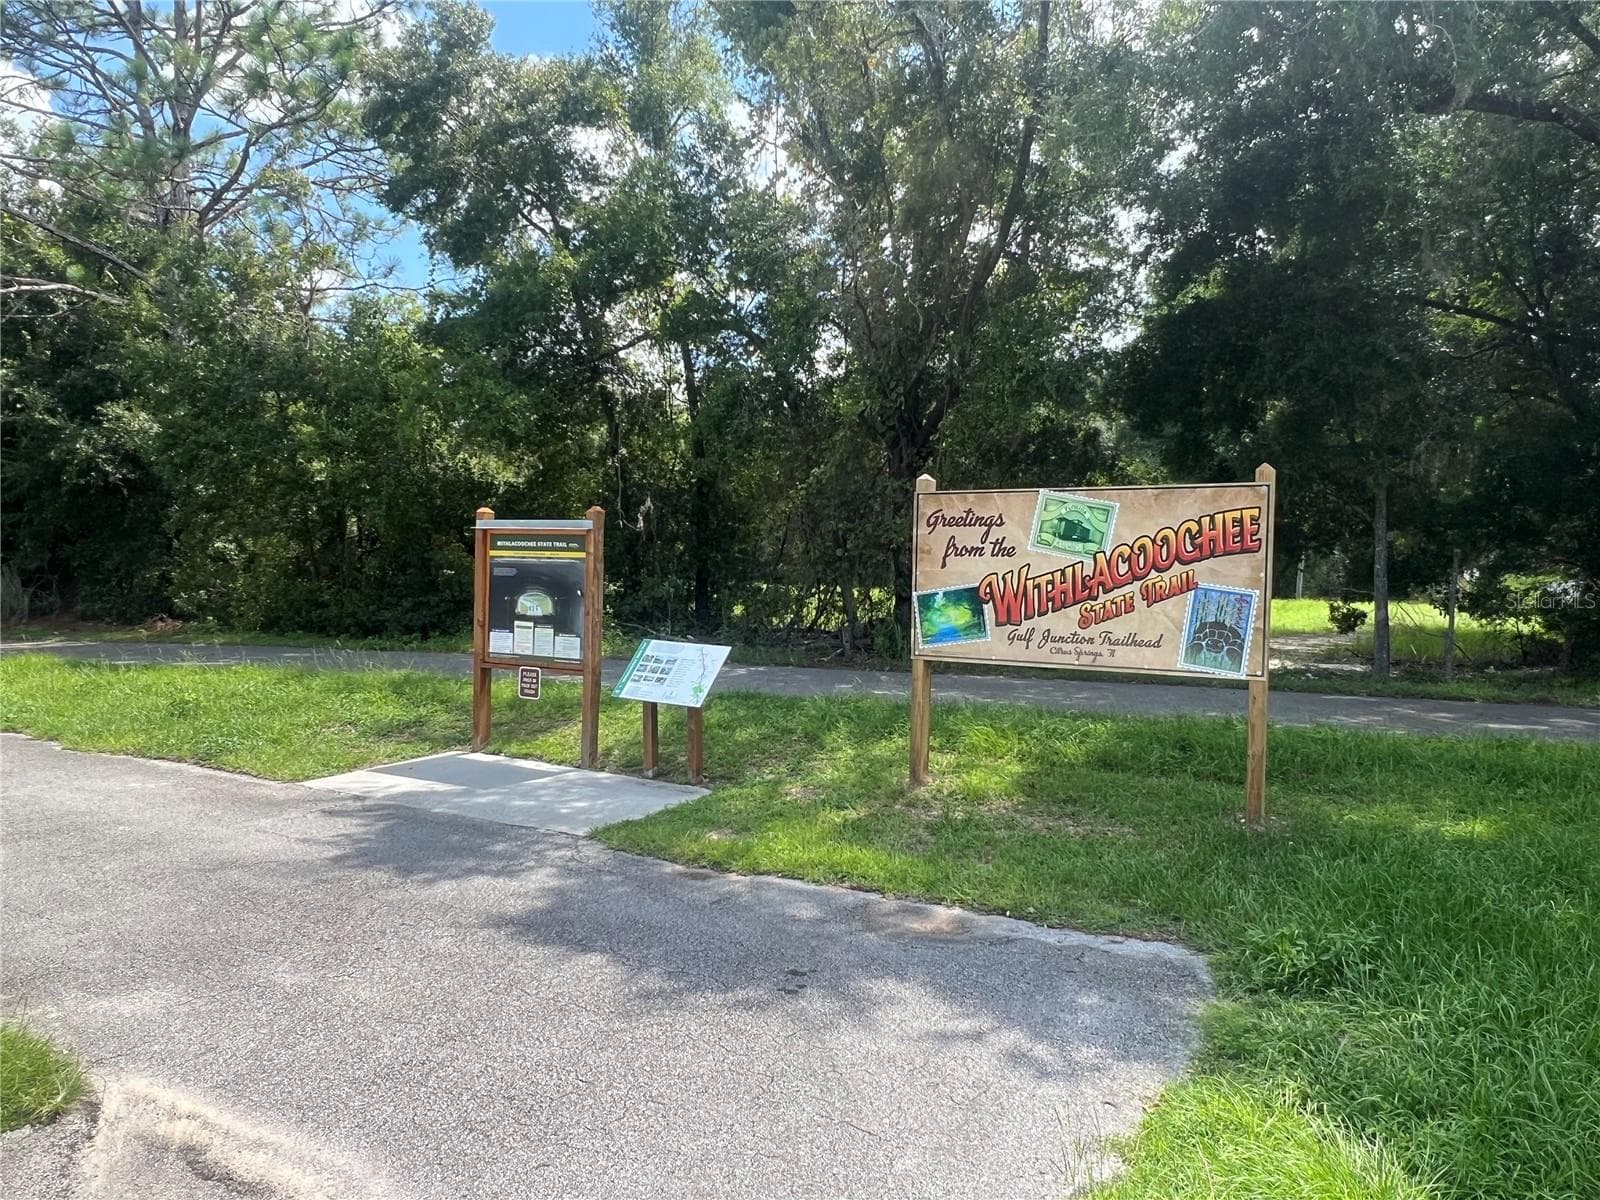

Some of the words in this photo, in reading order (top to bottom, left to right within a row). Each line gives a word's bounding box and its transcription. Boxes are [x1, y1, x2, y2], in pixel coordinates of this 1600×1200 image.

[926, 508, 1006, 544] Greetings
[940, 535, 986, 569] from
[989, 536, 1017, 558] the
[979, 507, 1262, 628] WITHLACOOCHEE
[1078, 591, 1136, 630] STATE
[1140, 569, 1199, 608] TRAIL
[1007, 627, 1036, 650] Gulf
[1037, 628, 1095, 649] Junction
[1099, 630, 1164, 649] Trailhead
